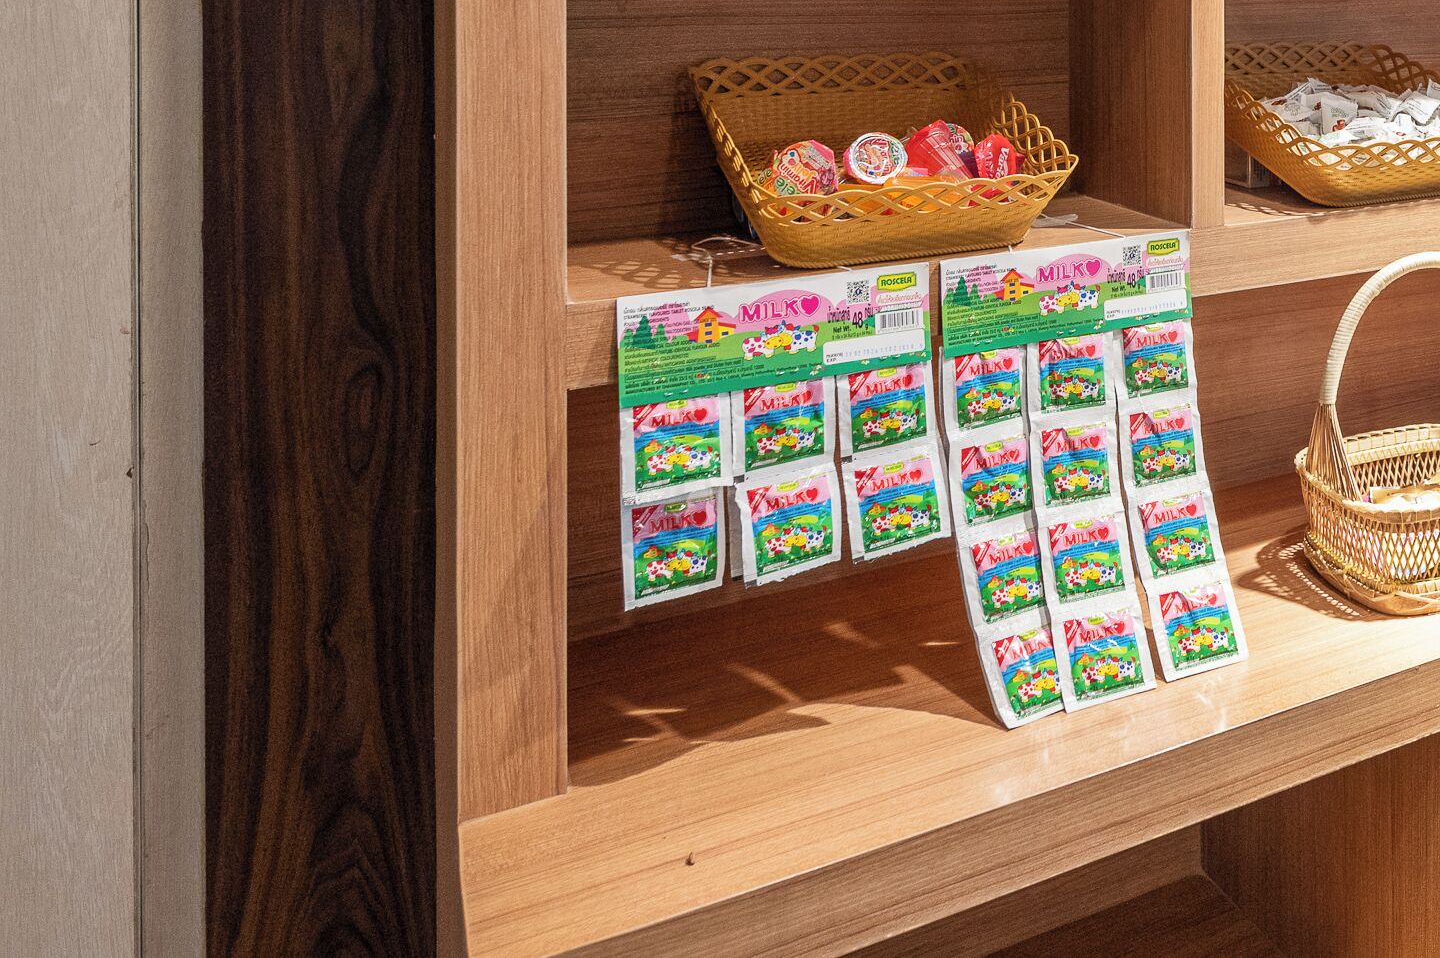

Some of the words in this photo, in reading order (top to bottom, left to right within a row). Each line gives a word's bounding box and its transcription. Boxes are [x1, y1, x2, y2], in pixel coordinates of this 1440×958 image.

[776, 177, 801, 195] ele
[1150, 242, 1176, 251] ROSCELA
[1038, 260, 1084, 283] MILK
[881, 276, 912, 287] ROSCELA
[1127, 272, 1137, 289] 48
[740, 297, 799, 323] MILK
[852, 310, 864, 329] 48
[1136, 332, 1168, 347] MILK
[970, 360, 1002, 376] MILK
[864, 378, 901, 396] MILK
[1144, 419, 1175, 435] MILK
[1057, 437, 1088, 453] MILK
[976, 453, 1008, 470] MILK
[872, 473, 909, 492] MILK
[650, 514, 692, 533] MILK
[1154, 507, 1187, 524] MILK
[1065, 530, 1098, 547] MILK
[988, 546, 1024, 565] MILK
[1079, 623, 1117, 644] MILK
